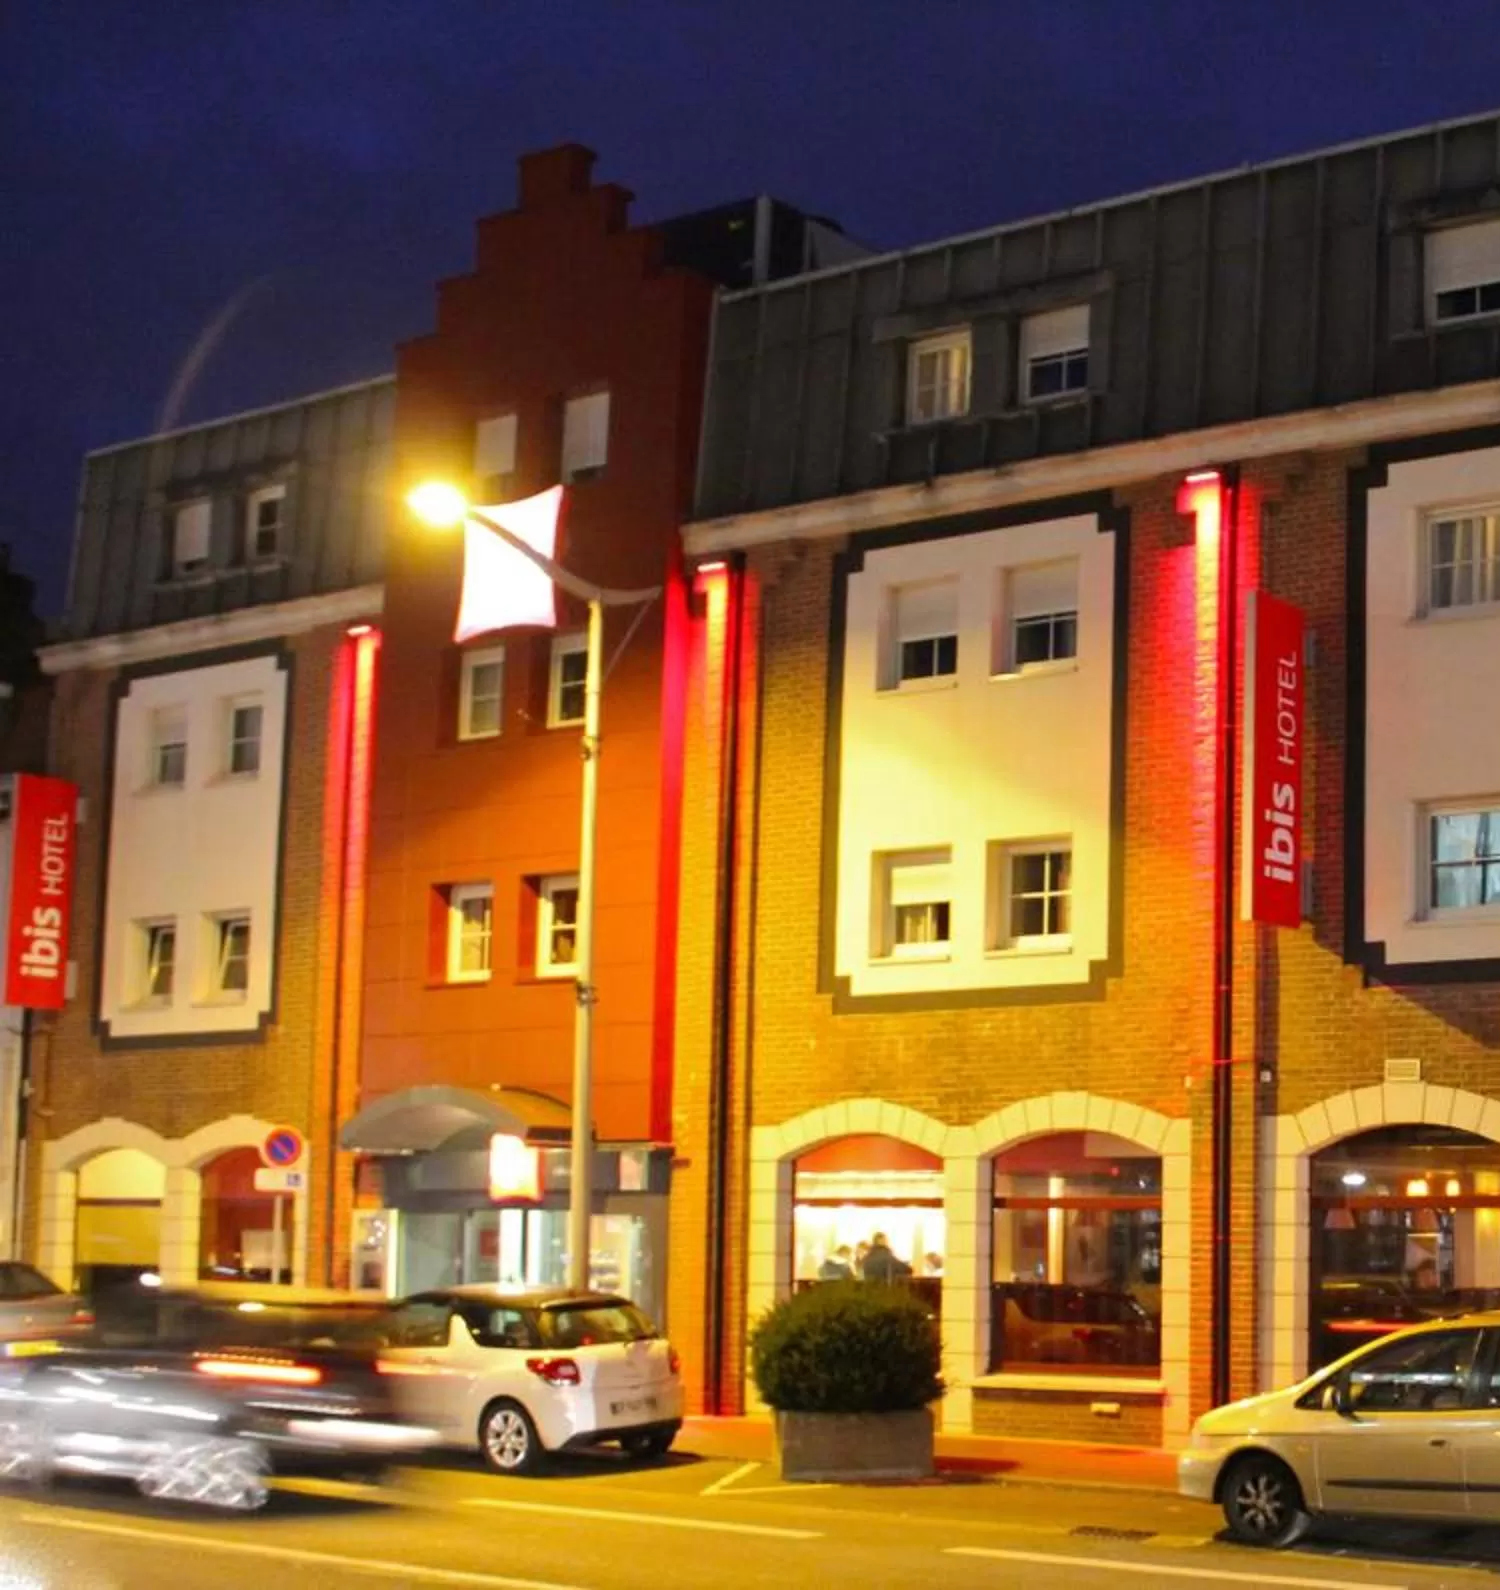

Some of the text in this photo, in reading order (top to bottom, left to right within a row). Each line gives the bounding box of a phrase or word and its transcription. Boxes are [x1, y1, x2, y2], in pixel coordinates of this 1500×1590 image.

[1264, 651, 1297, 883] ibis HOTEL
[19, 812, 69, 979] ibis HOTEL
